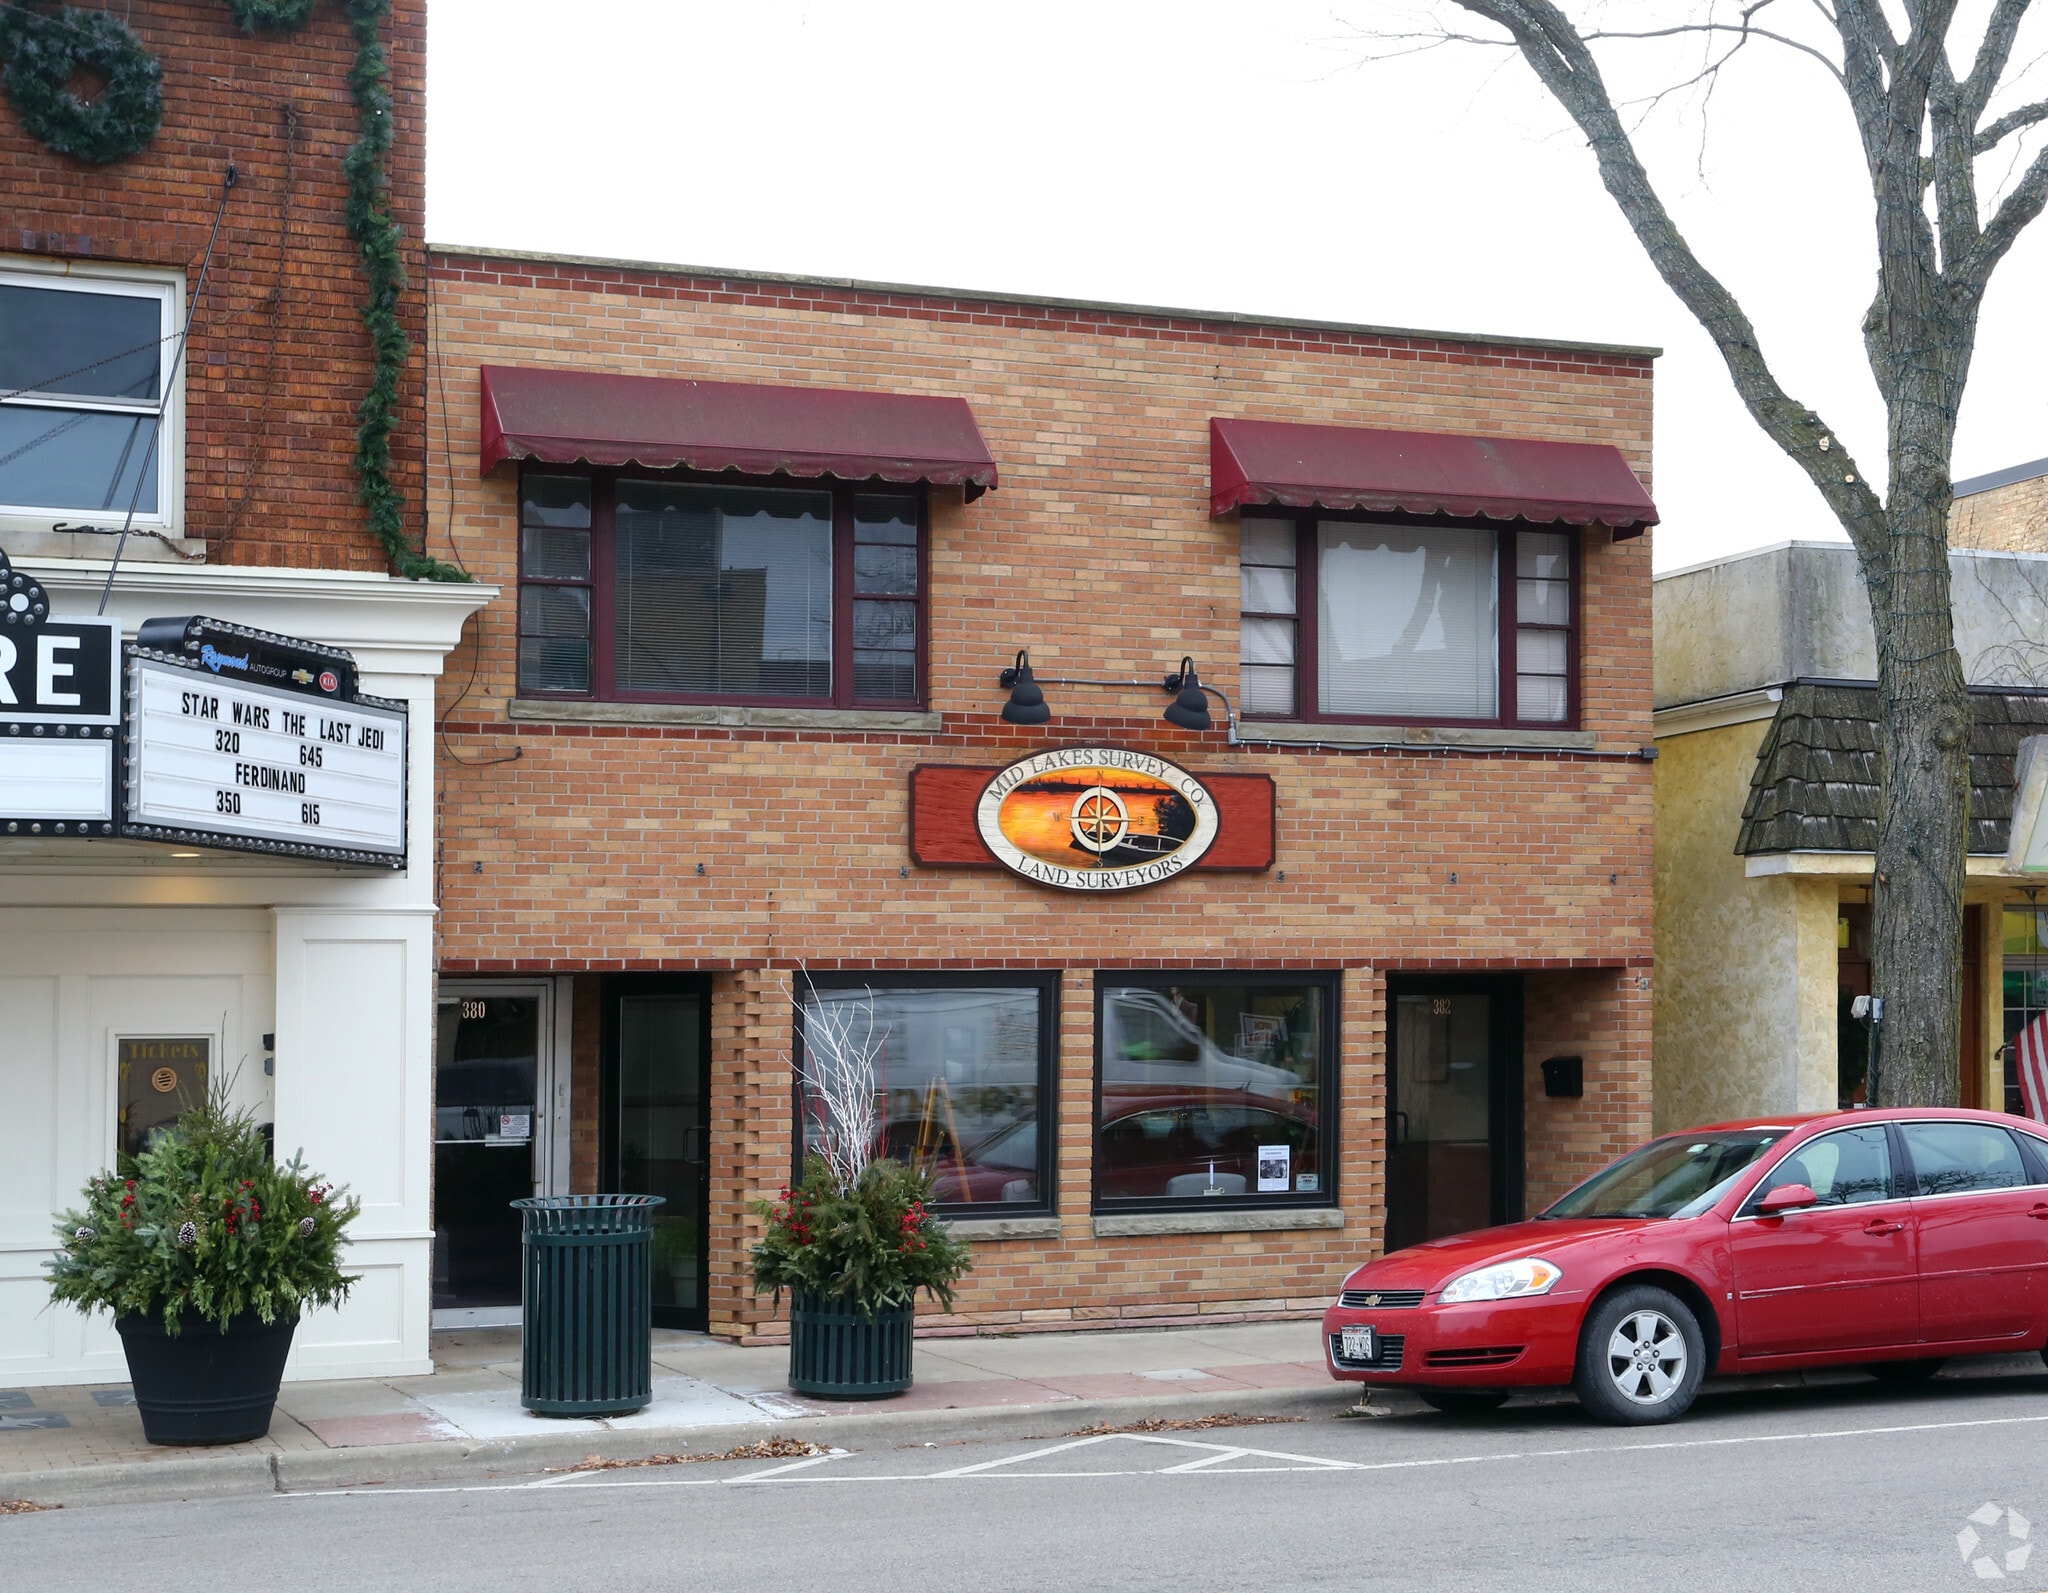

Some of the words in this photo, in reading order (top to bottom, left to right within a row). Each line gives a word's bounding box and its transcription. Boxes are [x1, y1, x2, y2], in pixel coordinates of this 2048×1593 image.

[201, 644, 249, 673] Raymond
[250, 663, 288, 678] AUTOGROUP
[322, 677, 334, 687] KIA
[182, 692, 218, 719] STAR
[232, 702, 270, 729] WARS
[282, 711, 306, 736] THE
[320, 719, 351, 744] LAST
[358, 726, 384, 751] JEDI
[215, 729, 240, 754] 320
[300, 745, 323, 768] 645
[235, 763, 306, 794] FERDINAND
[988, 766, 1024, 801] MID
[1030, 749, 1093, 774] LAKES
[1099, 749, 1170, 778] SURVEY
[216, 790, 241, 815] 350
[302, 803, 320, 825] 615
[1018, 855, 1069, 885] LAND
[1076, 855, 1183, 888] SURVEYORS
[462, 1001, 486, 1019] 380
[1433, 999, 1451, 1015] 382
[130, 1042, 200, 1059] Tickets
